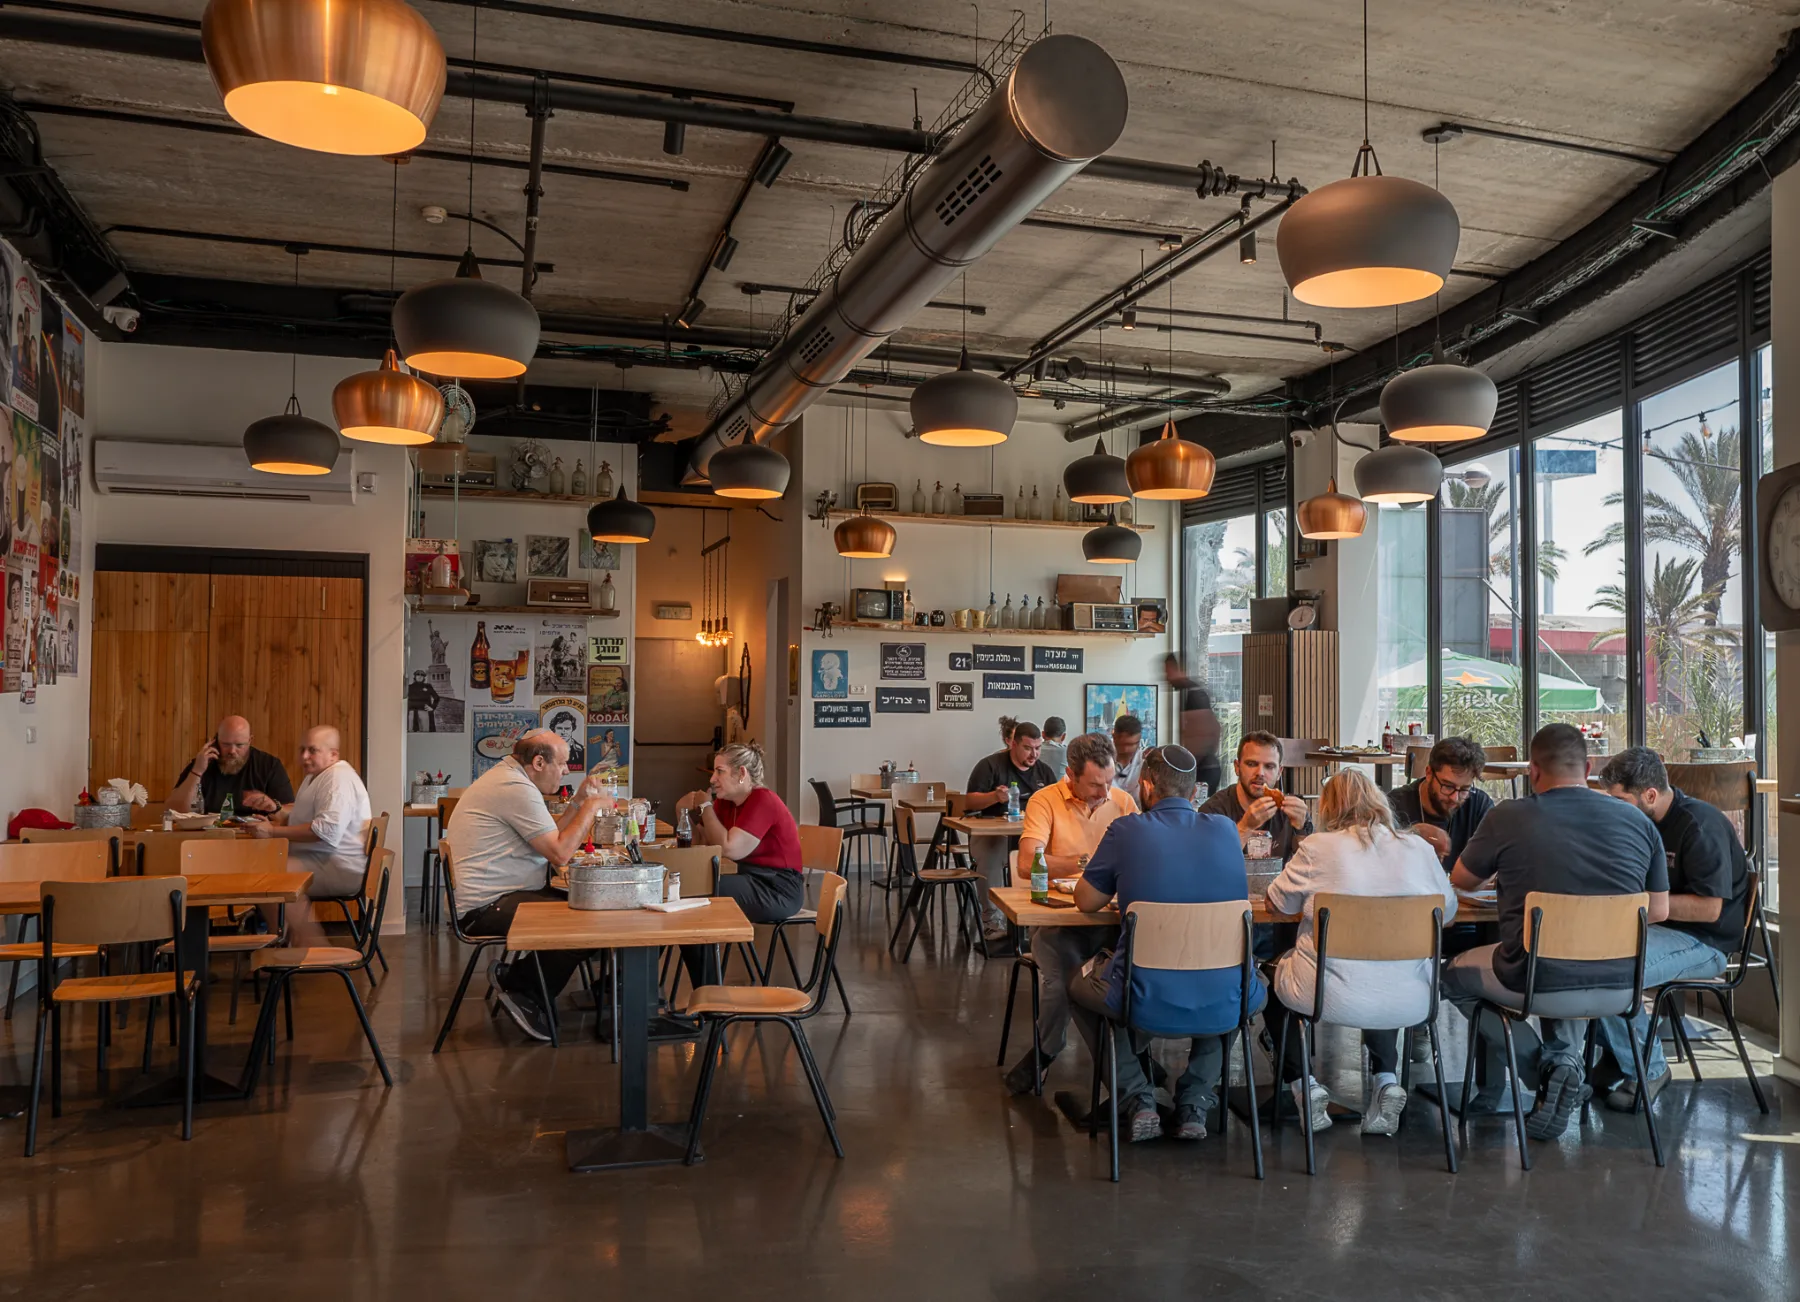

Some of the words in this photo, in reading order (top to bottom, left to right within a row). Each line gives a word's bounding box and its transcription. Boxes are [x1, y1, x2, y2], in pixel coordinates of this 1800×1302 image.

[1773, 546, 1779, 559] 9
[1779, 570, 1784, 584] 8
[1788, 588, 1794, 600] 7
[592, 637, 624, 645] מרחב
[596, 645, 620, 654] מוגן
[995, 653, 1011, 662] נחלת
[1045, 650, 1067, 659] מצדה
[955, 657, 966, 667] 21
[987, 682, 1021, 691] העצמאות
[542, 699, 565, 710] גולדסטאר
[822, 705, 848, 714] הפועלים
[589, 713, 629, 723] KODAK
